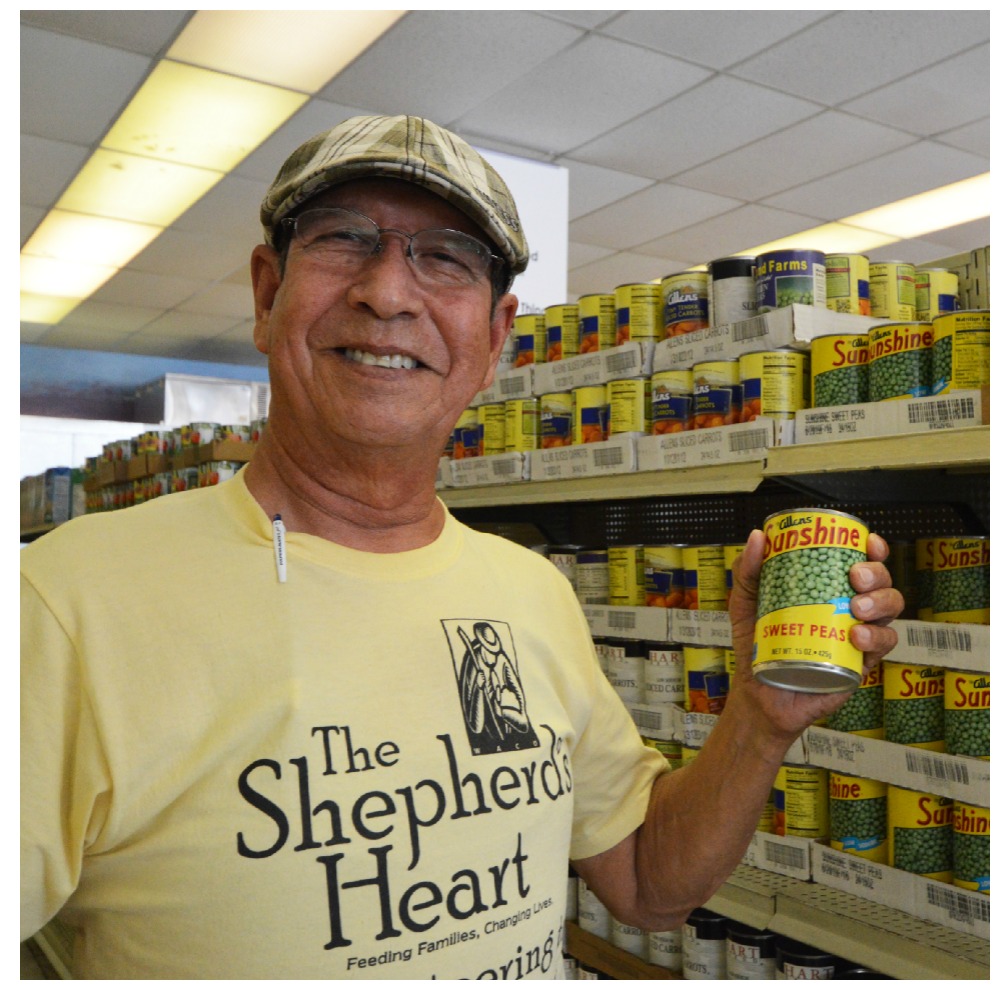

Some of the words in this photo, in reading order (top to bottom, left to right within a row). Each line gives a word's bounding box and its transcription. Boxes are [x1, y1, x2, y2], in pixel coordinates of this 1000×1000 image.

[768, 260, 808, 273] Farms
[870, 328, 933, 359] unshine
[850, 409, 866, 420] PEAS
[763, 516, 860, 560] Sunshine
[777, 515, 813, 530] Allens
[762, 623, 804, 638] SWEET
[809, 623, 846, 642] PEAS
[311, 725, 400, 776] The
[472, 740, 538, 754] WACO
[236, 723, 572, 871] Shepherd's
[316, 832, 530, 950] Heart
[346, 948, 413, 971] Feeding
[417, 928, 481, 956] Families,
[484, 907, 532, 935] Changing
